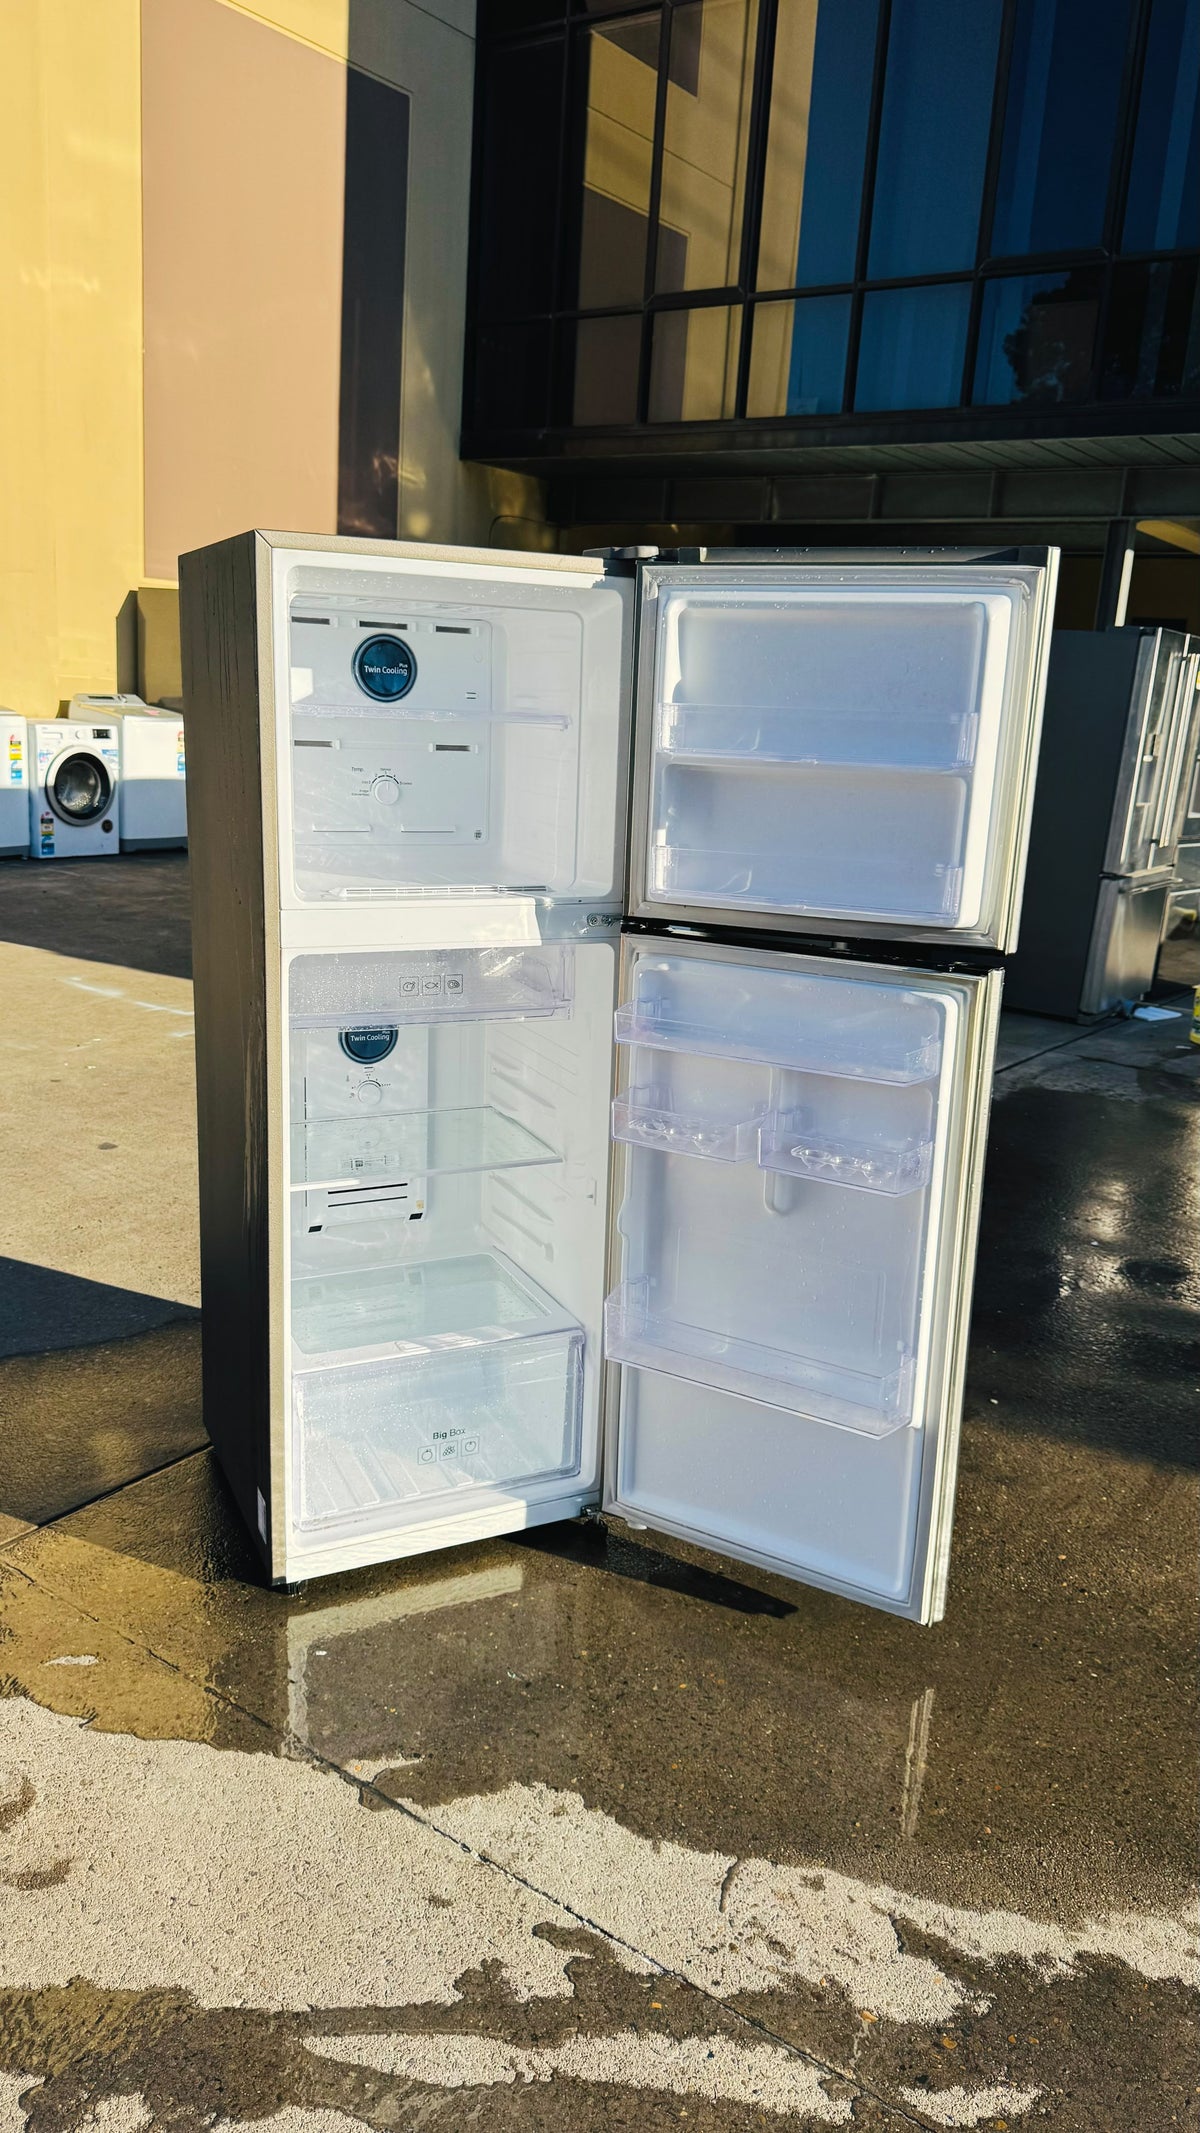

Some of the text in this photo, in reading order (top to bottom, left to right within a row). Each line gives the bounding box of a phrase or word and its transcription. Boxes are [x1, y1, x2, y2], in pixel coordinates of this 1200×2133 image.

[364, 665, 408, 677] Twin Cooling
[366, 1033, 390, 1041] Cooling
[432, 1428, 466, 1440] Big Box
